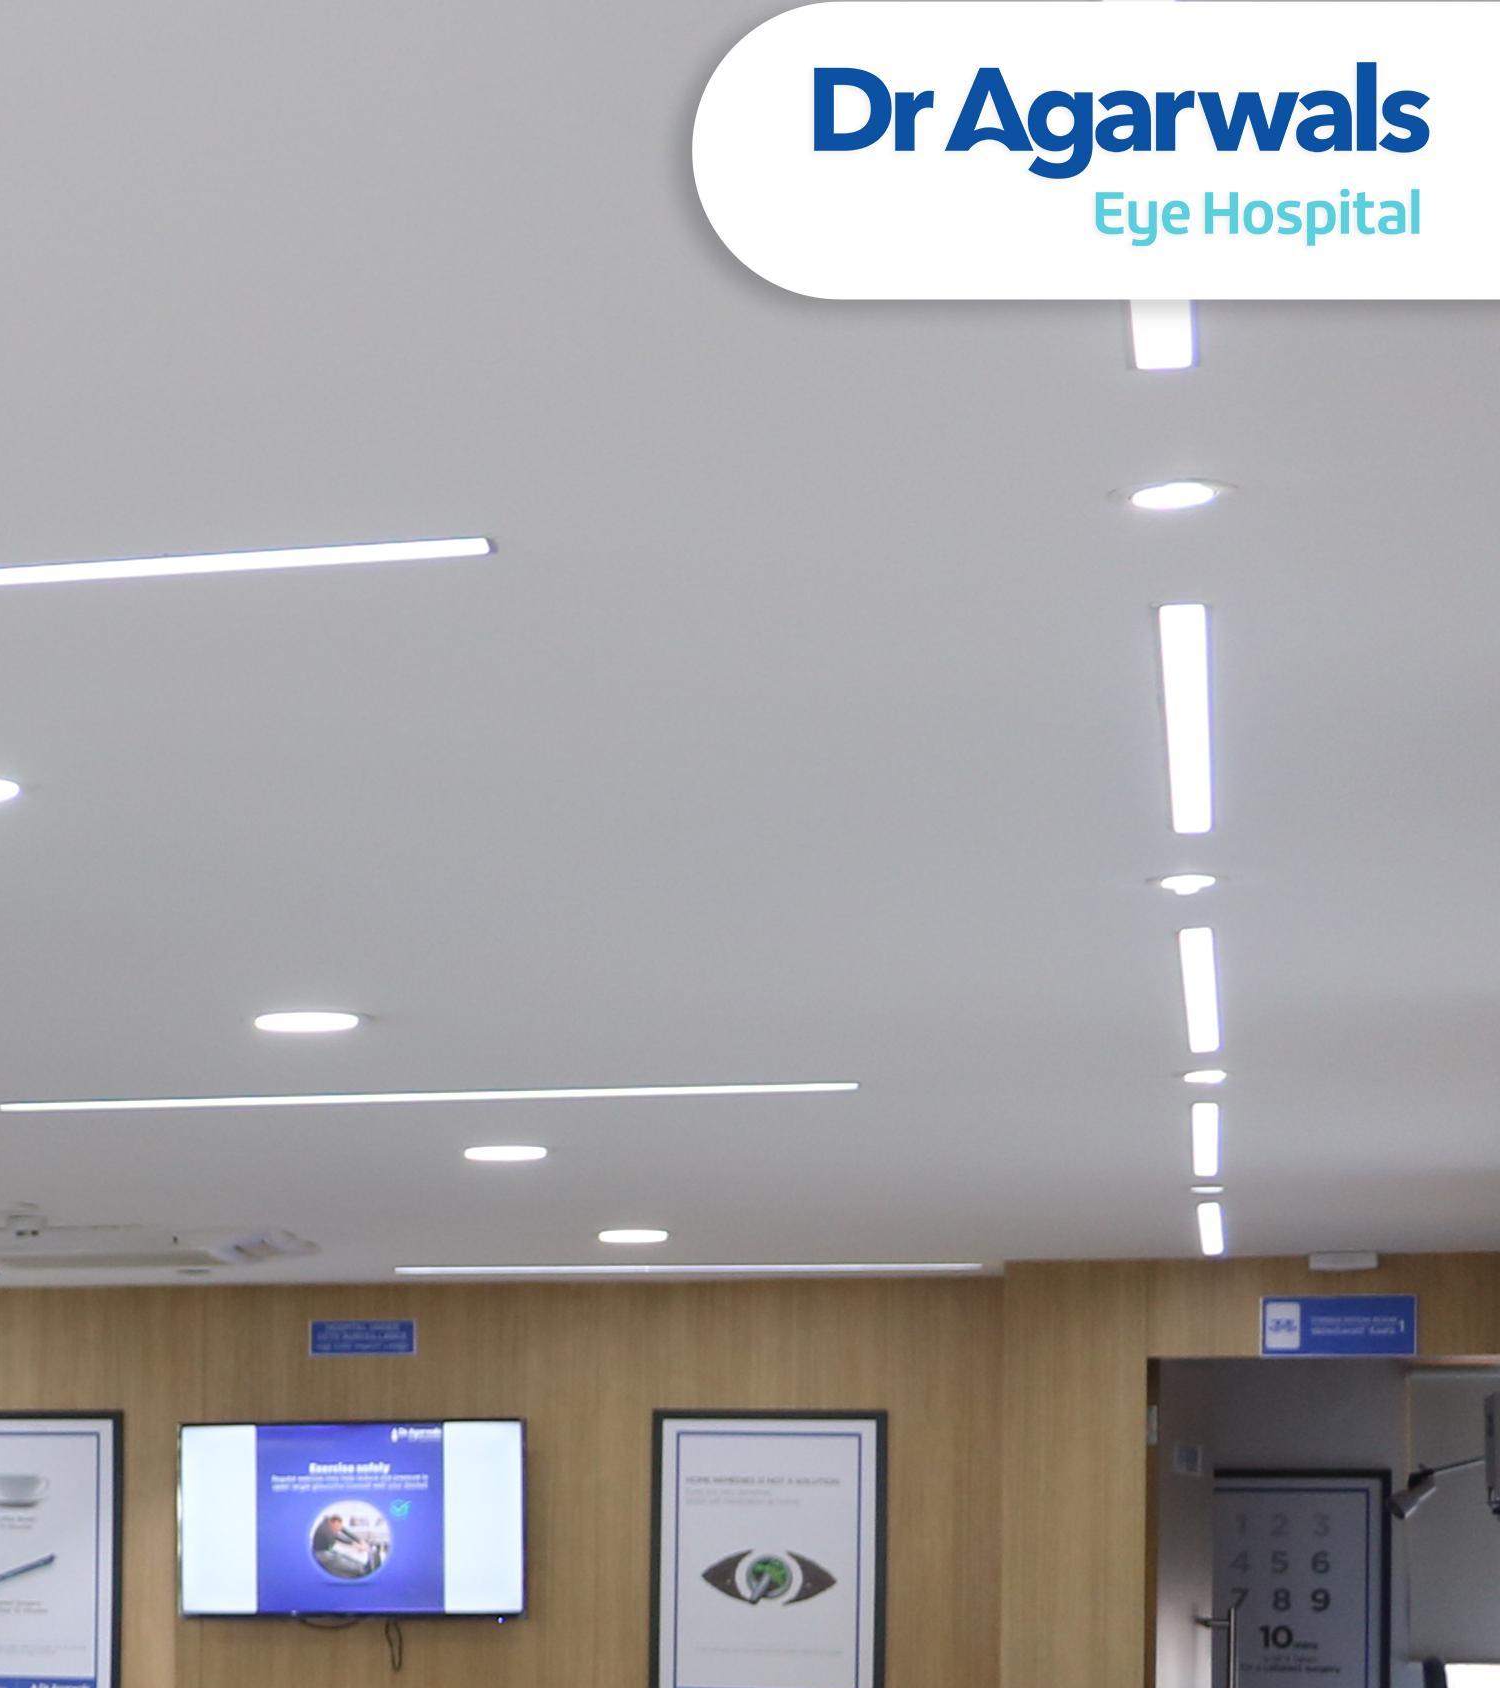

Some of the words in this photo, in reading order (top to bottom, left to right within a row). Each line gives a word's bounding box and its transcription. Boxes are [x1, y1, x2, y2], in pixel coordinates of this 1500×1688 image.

[1235, 1514, 1247, 1536] 1
[1269, 1513, 1289, 1537] 2
[1313, 1514, 1330, 1537] 3
[1230, 1552, 1250, 1574] 4
[1271, 1551, 1289, 1574] 5
[1311, 1551, 1330, 1574] 6
[1230, 1587, 1249, 1610] 7
[1272, 1587, 1291, 1611] 8
[1310, 1588, 1331, 1612] 9
[1259, 1625, 1293, 1649] 10
